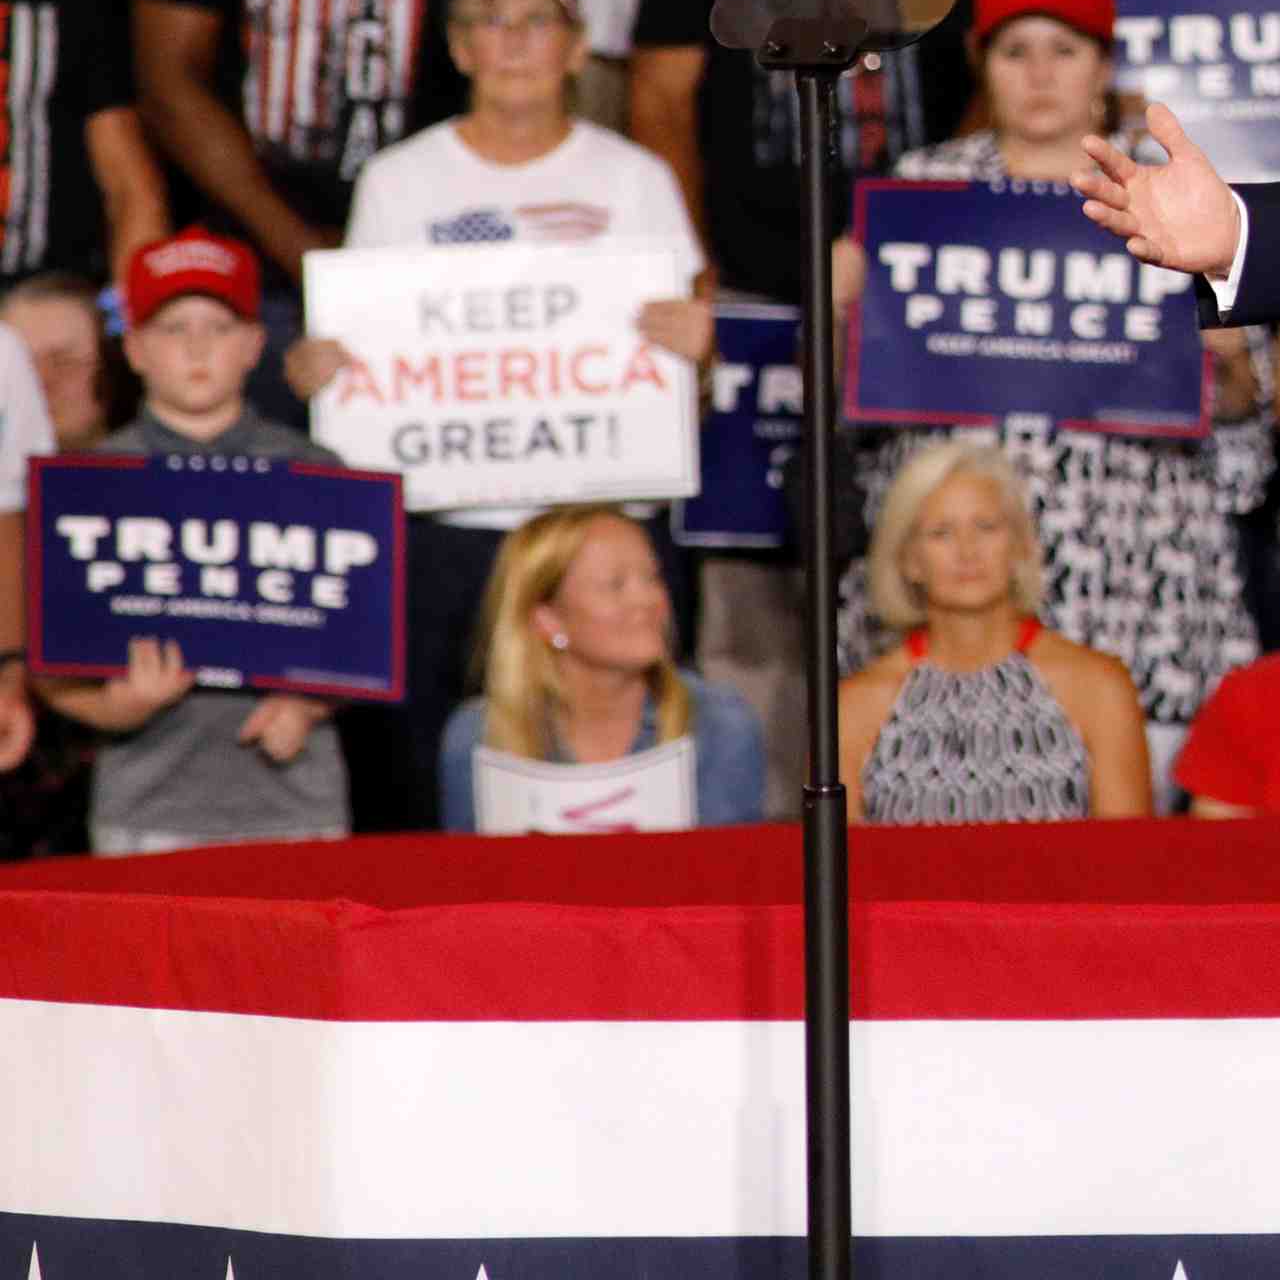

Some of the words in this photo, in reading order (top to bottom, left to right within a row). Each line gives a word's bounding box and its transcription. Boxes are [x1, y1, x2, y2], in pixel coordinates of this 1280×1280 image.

[877, 241, 1193, 305] TRUMP
[416, 282, 579, 334] KEEP
[905, 294, 1162, 342] PENCE
[337, 342, 669, 408] AMERICA
[390, 412, 622, 466] GREAT!
[55, 514, 378, 575] TRUMP
[86, 560, 349, 610] PENCE
